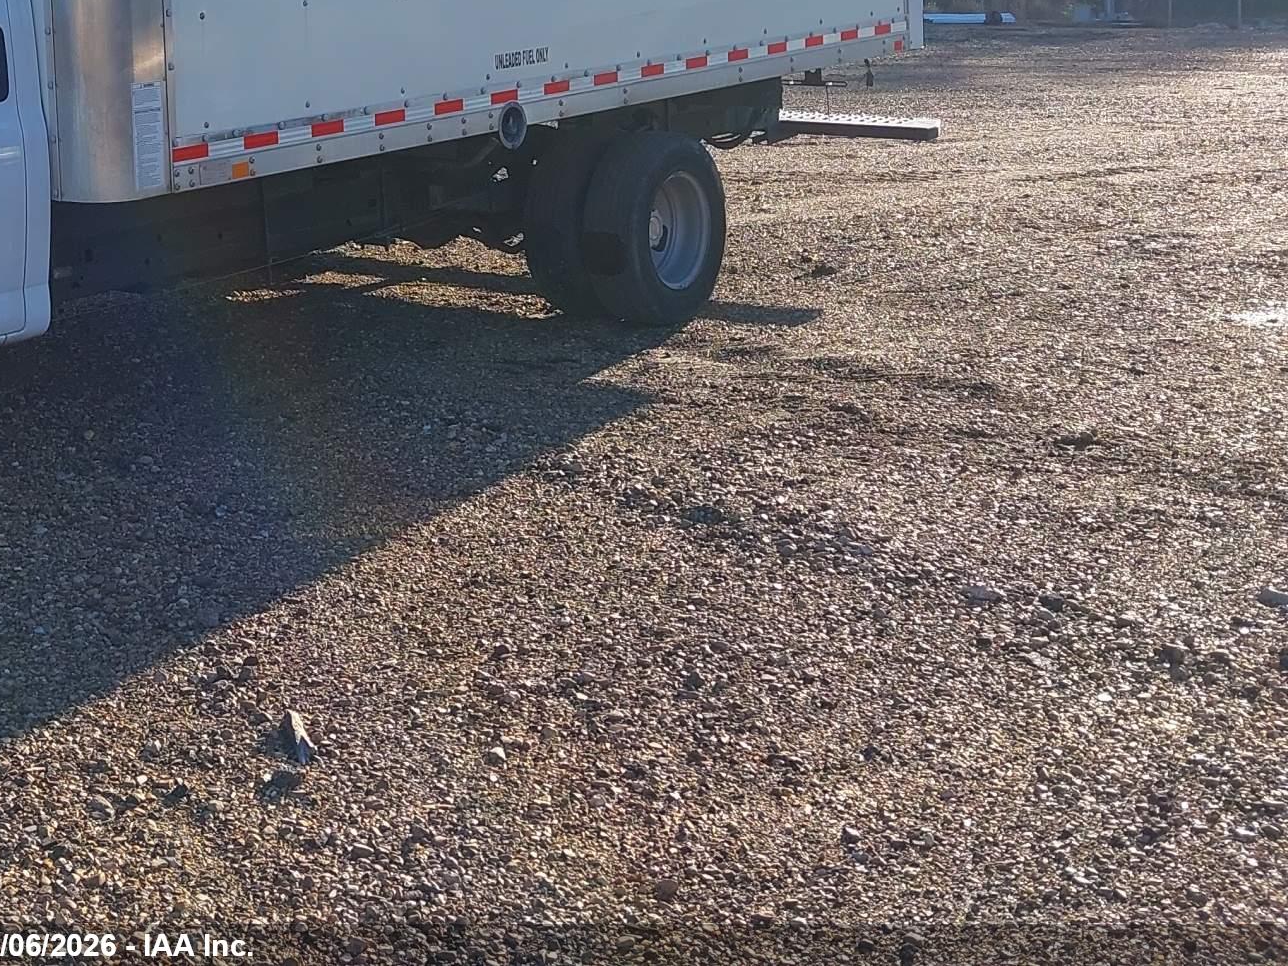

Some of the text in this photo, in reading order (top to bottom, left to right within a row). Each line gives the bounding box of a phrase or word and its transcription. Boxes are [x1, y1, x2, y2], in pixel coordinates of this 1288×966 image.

[494, 46, 548, 70] UNLEADED FUEL ONLY
